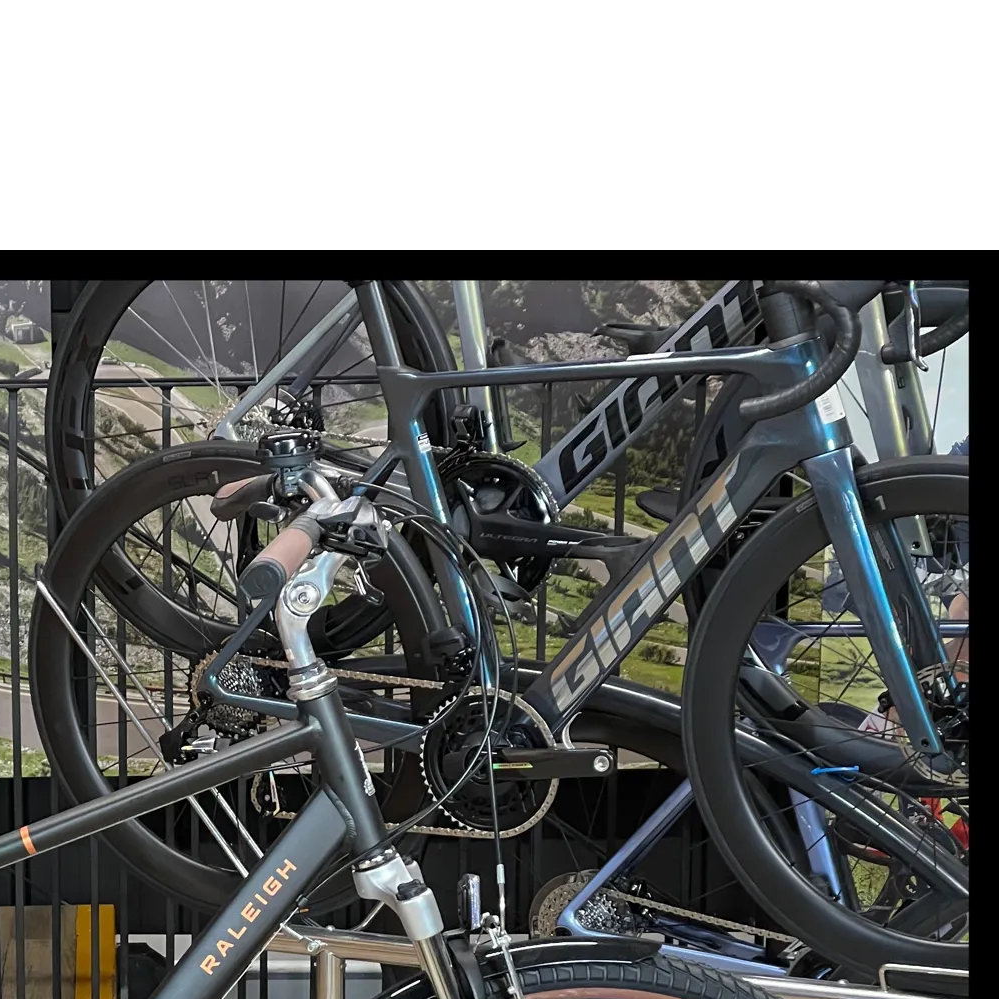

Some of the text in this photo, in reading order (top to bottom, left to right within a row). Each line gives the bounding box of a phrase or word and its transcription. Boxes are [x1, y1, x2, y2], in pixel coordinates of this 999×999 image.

[480, 532, 538, 543] ULTEGRA
[548, 453, 741, 713] GIANT
[200, 858, 298, 976] RALEIGH
